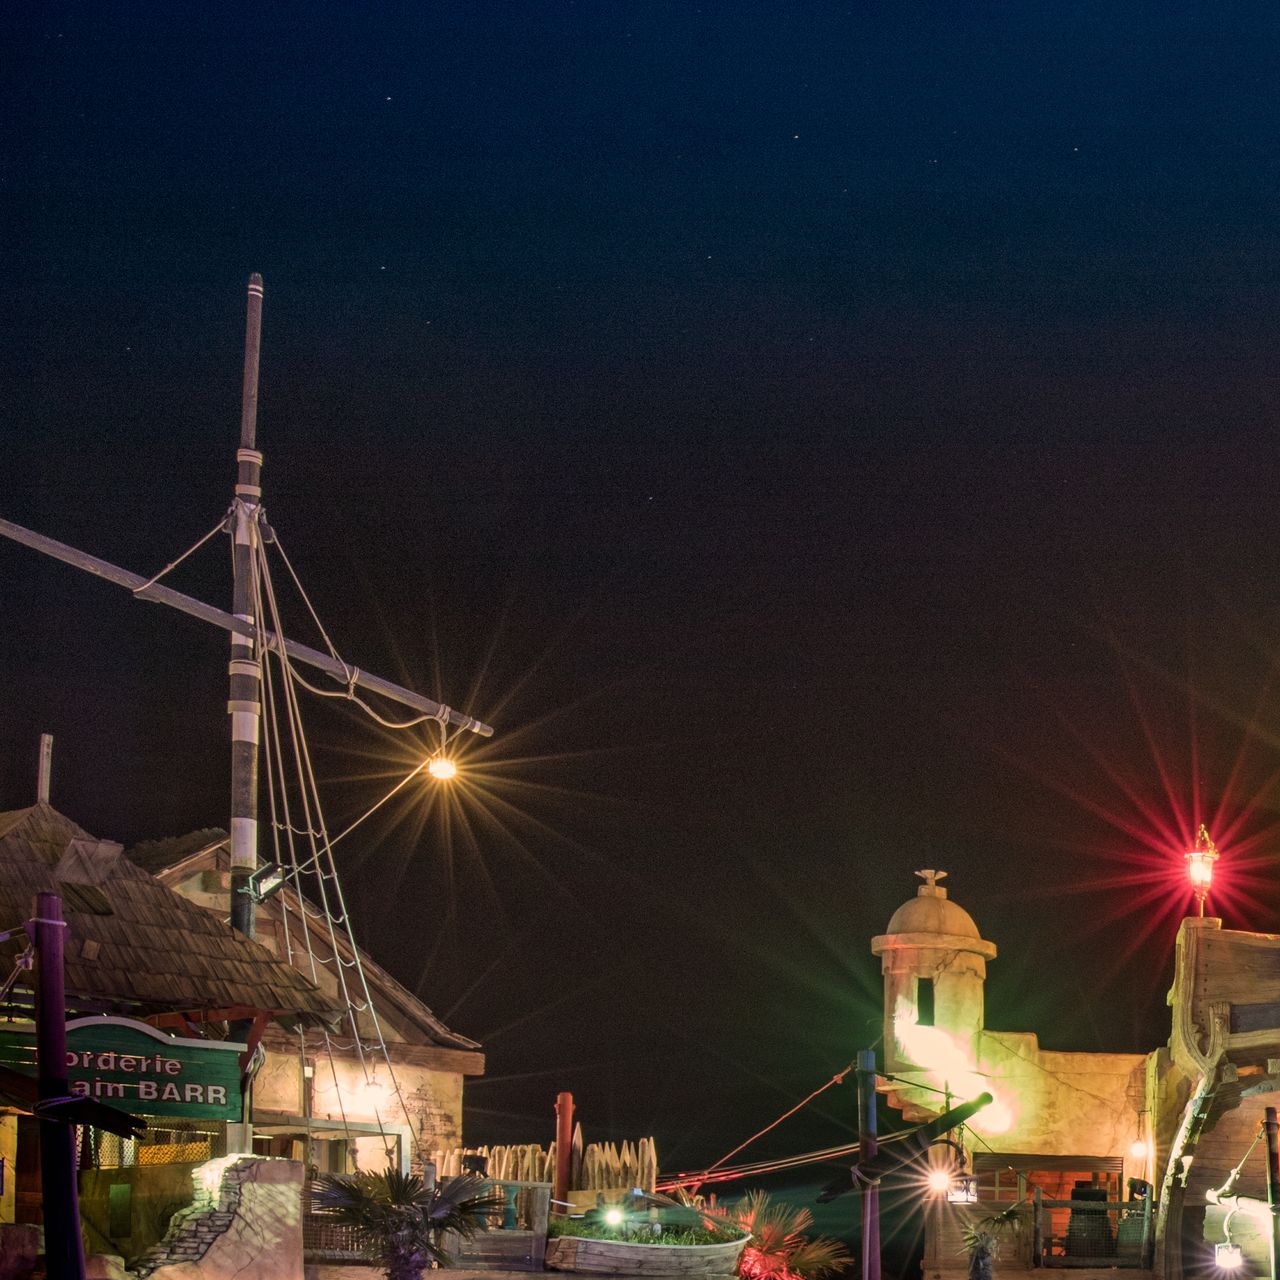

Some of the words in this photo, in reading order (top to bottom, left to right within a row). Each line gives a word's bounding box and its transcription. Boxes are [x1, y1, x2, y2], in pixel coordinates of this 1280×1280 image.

[36, 1051, 183, 1075] orderie
[71, 1077, 126, 1098] ain
[138, 1080, 227, 1105] BARR
